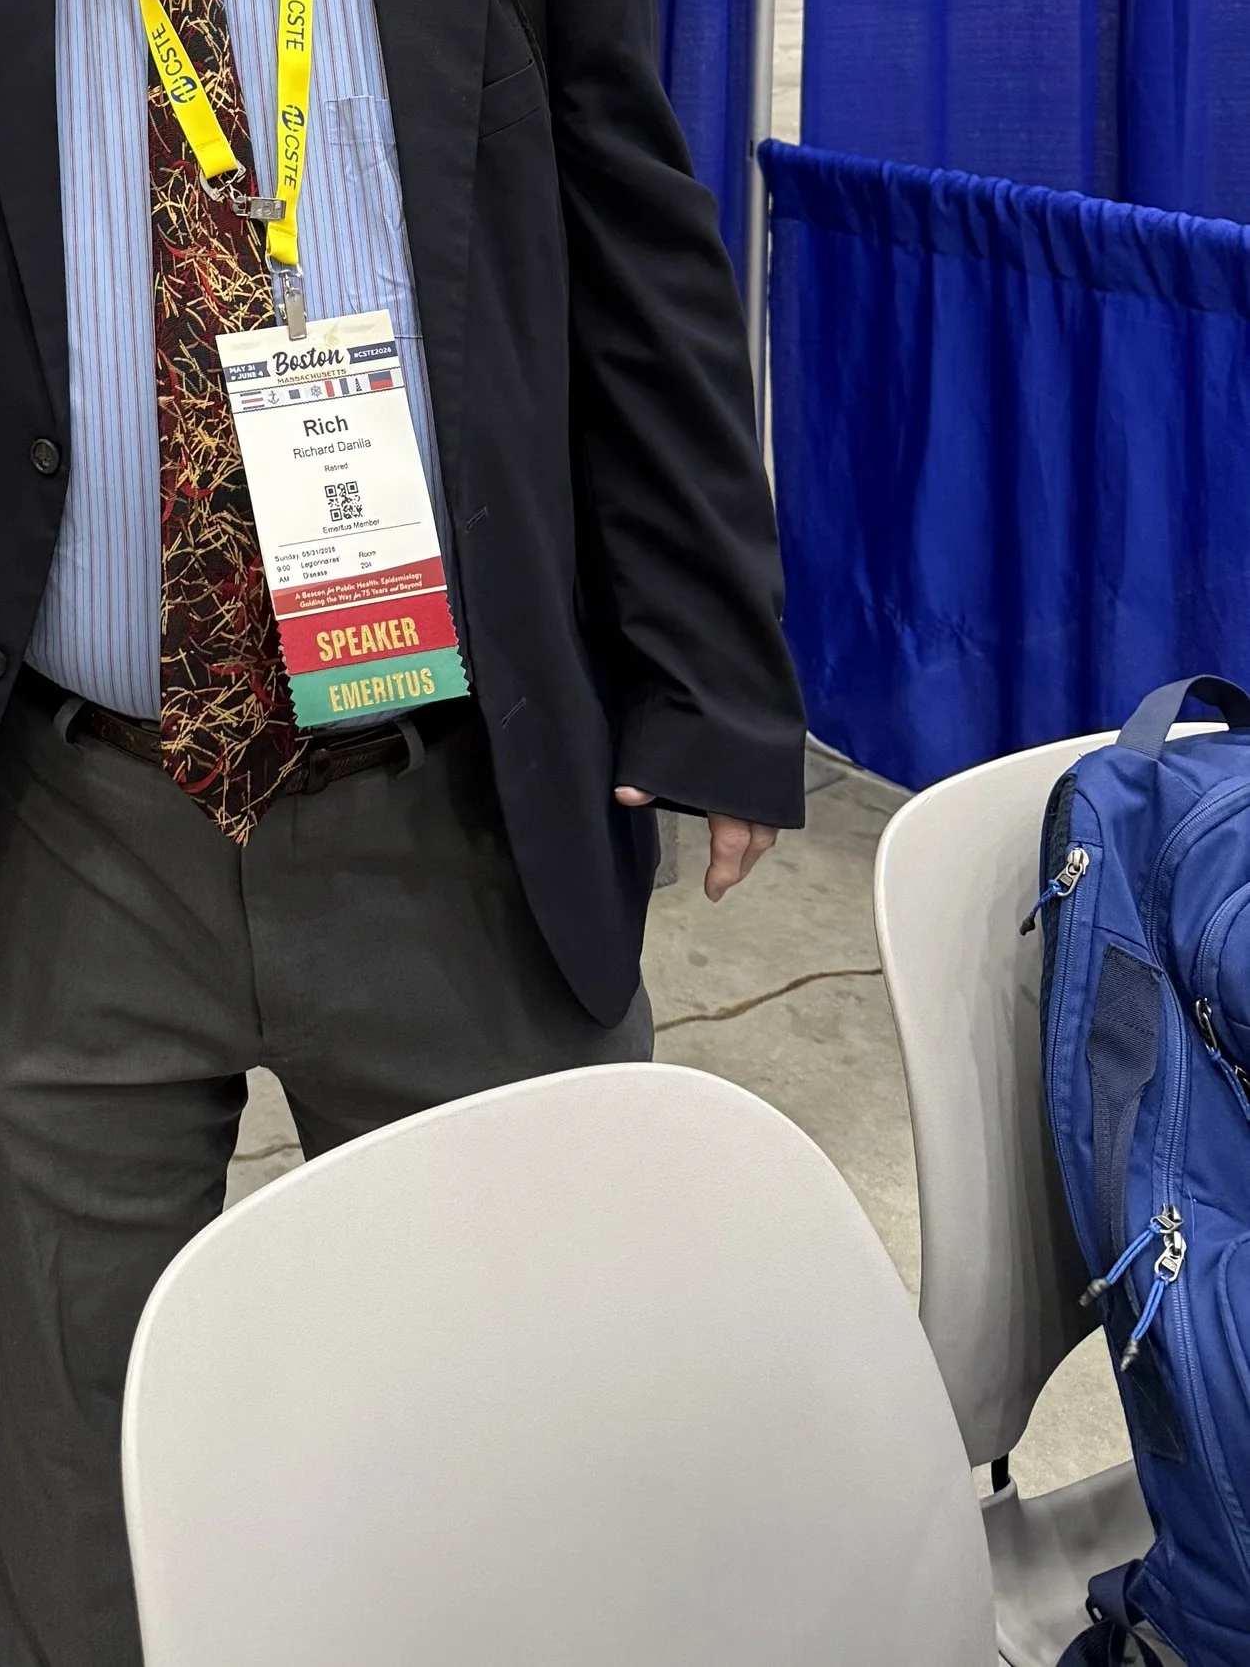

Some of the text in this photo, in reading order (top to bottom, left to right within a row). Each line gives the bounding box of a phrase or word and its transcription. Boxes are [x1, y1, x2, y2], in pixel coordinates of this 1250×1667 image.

[286, 0, 305, 52] CSTE
[152, 22, 183, 76] CSTE
[284, 134, 301, 190] CSTE
[229, 366, 246, 374] MAY
[272, 347, 345, 376] Boston
[238, 372, 258, 380] JUNE
[277, 369, 347, 385] MASSACHUSETTS
[303, 415, 349, 437] Rich
[293, 443, 335, 459] Richard
[324, 462, 349, 472] Retired
[322, 519, 380, 534] Emeritus Member
[279, 575, 290, 583] AM
[301, 590, 326, 599] Beacon
[335, 583, 356, 592] Public
[380, 573, 423, 585] Epidemiology
[300, 598, 326, 608] Guiding
[326, 596, 337, 604] the
[338, 594, 352, 602] Way
[371, 587, 389, 595] Years
[399, 580, 423, 591] Beyond
[316, 617, 420, 662] SPEAKER
[328, 667, 436, 712] EMERITUS
